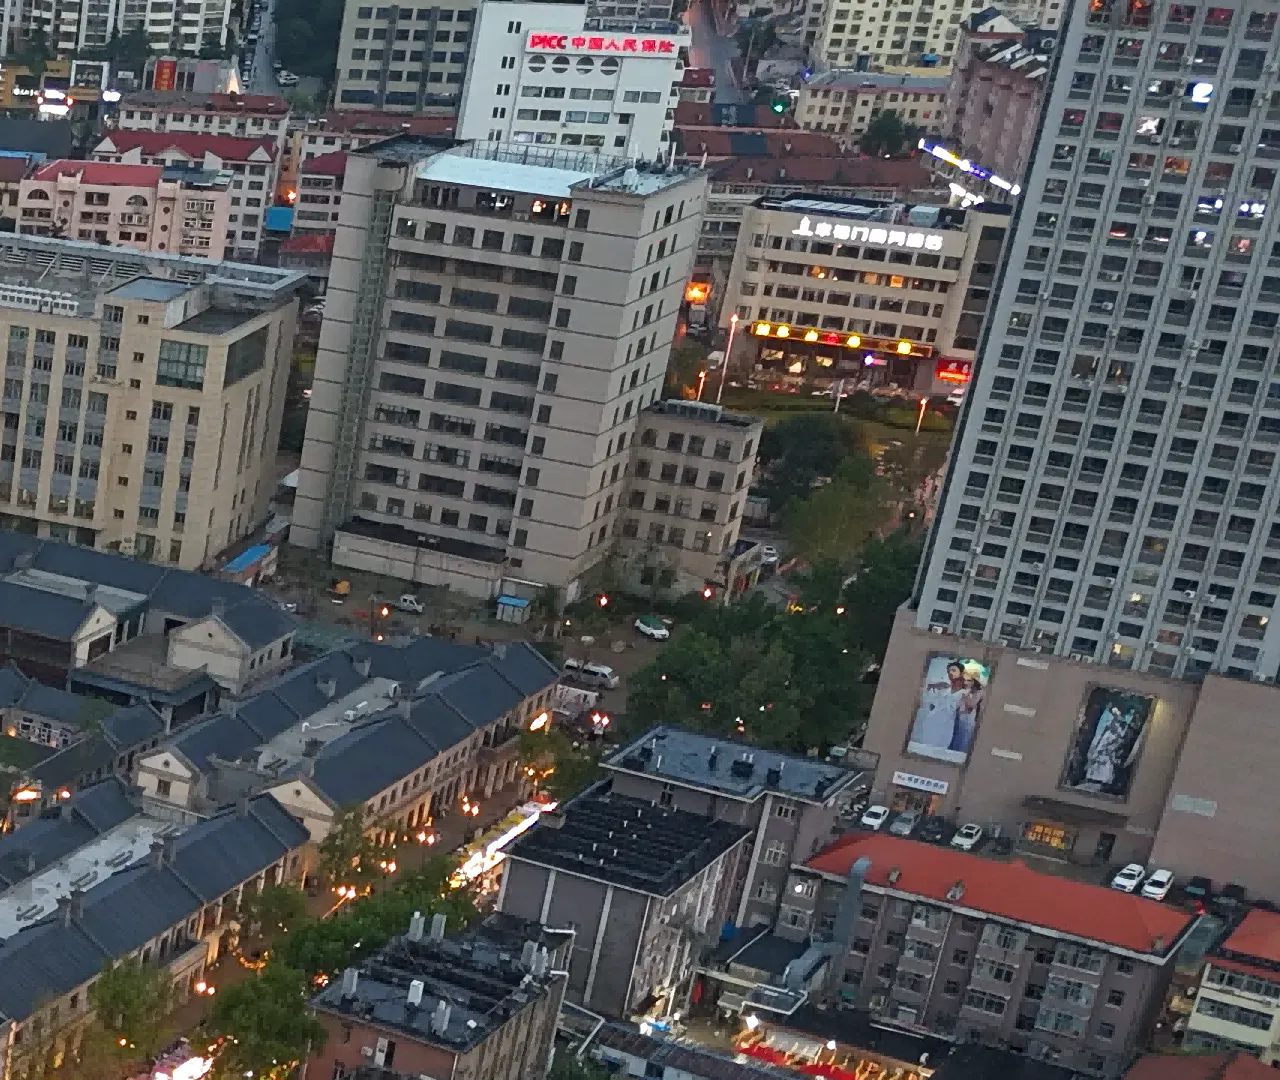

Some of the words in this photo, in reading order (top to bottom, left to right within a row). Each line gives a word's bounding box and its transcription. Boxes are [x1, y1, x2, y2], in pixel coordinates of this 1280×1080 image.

[571, 36, 675, 53] 中国人民保险
